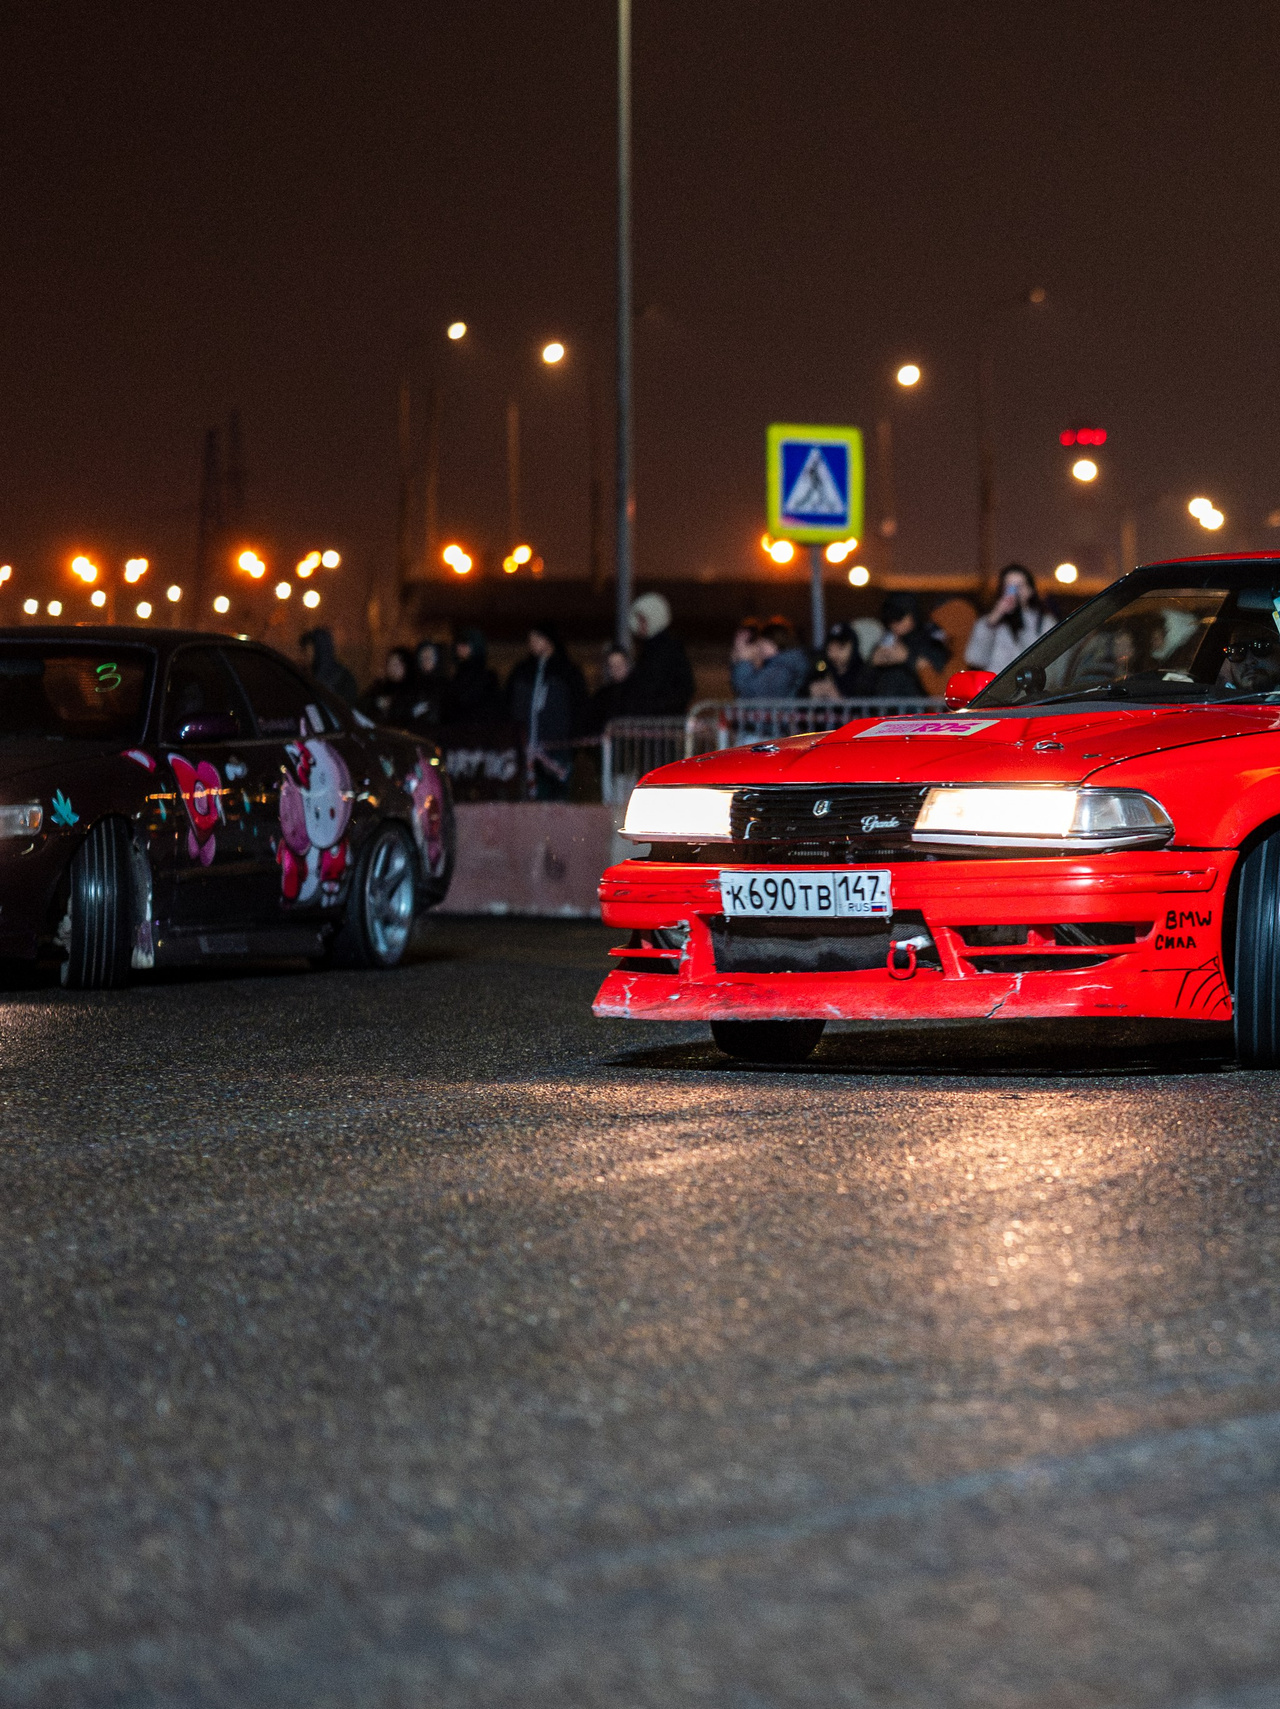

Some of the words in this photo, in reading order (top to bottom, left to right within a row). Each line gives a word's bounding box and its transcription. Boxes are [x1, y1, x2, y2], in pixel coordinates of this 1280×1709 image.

[95, 662, 122, 692] 3
[911, 722, 982, 733] RDS
[861, 815, 900, 833] Grande
[838, 875, 880, 901] 147
[848, 902, 871, 912] RUS
[1166, 910, 1212, 929] BMW
[1155, 934, 1197, 950] СИЛА
